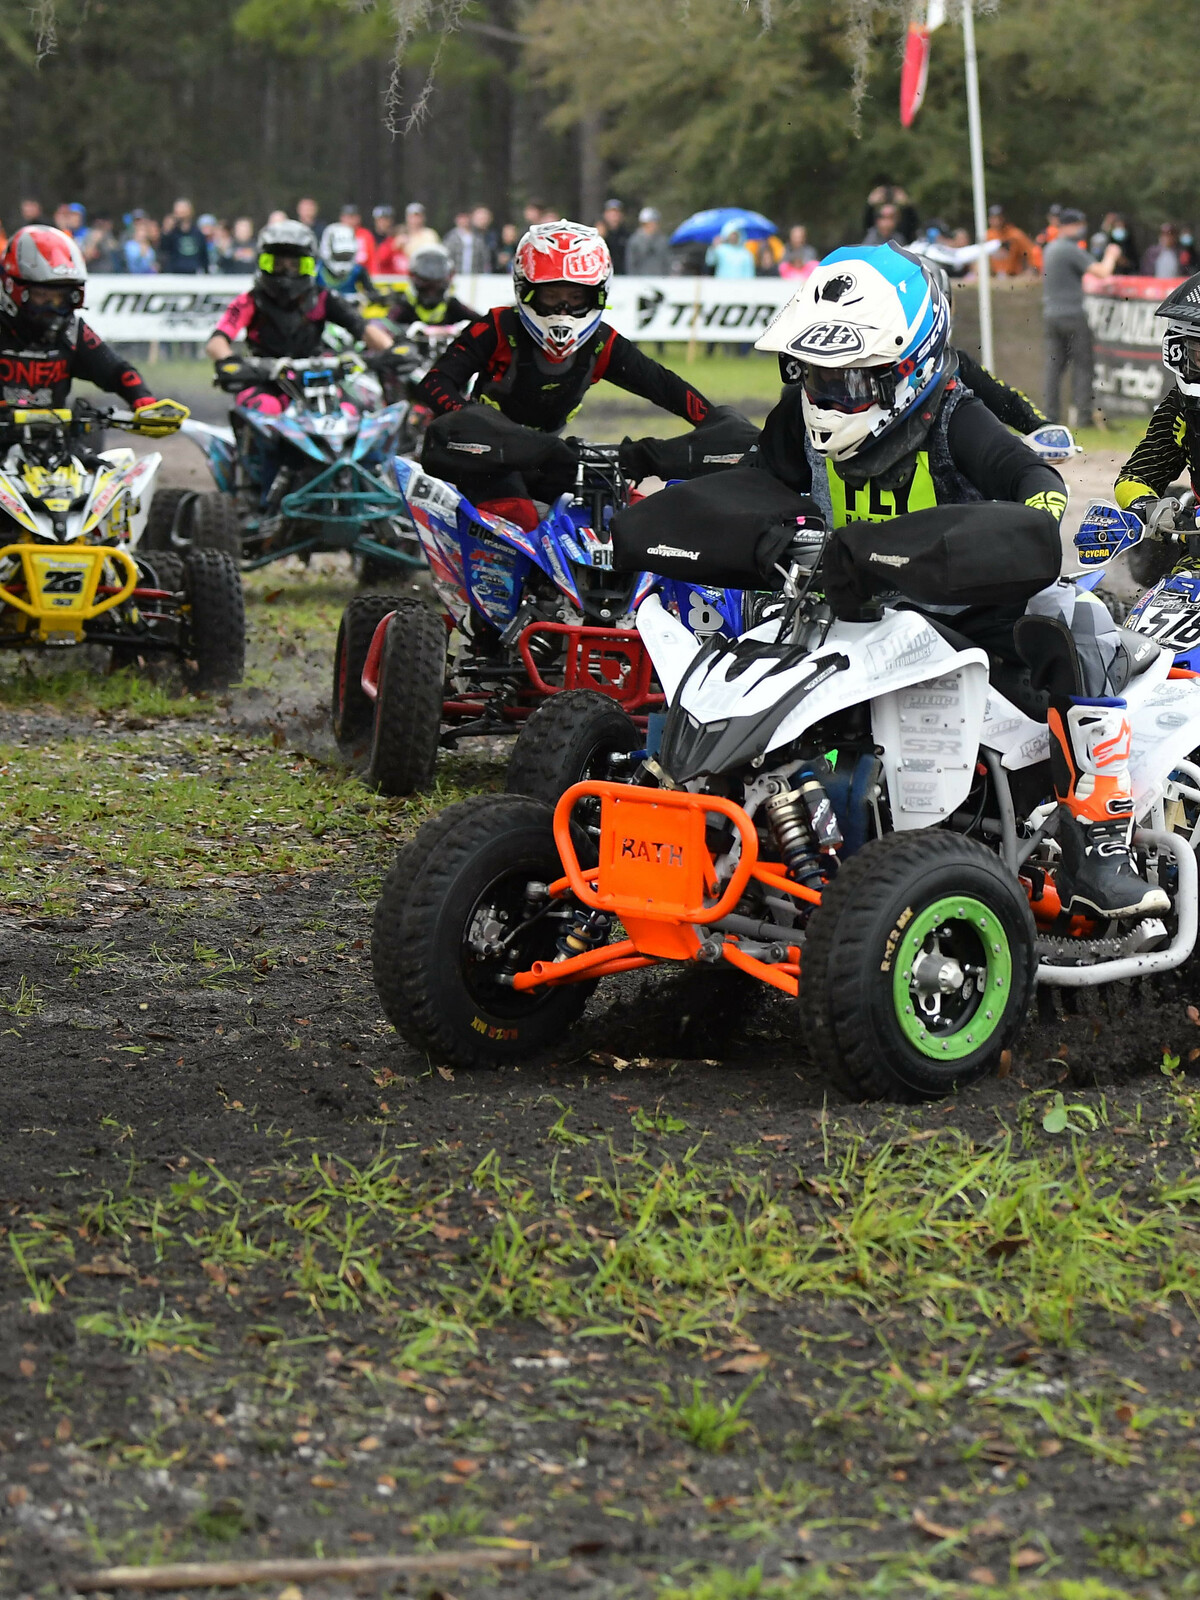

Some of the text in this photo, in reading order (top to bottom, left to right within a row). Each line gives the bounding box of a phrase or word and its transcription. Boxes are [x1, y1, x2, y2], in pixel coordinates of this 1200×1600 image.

[101, 293, 241, 314] MOOS
[668, 302, 777, 328] THOR
[1085, 549, 1110, 558] CYCRA
[621, 838, 684, 866] RATH
